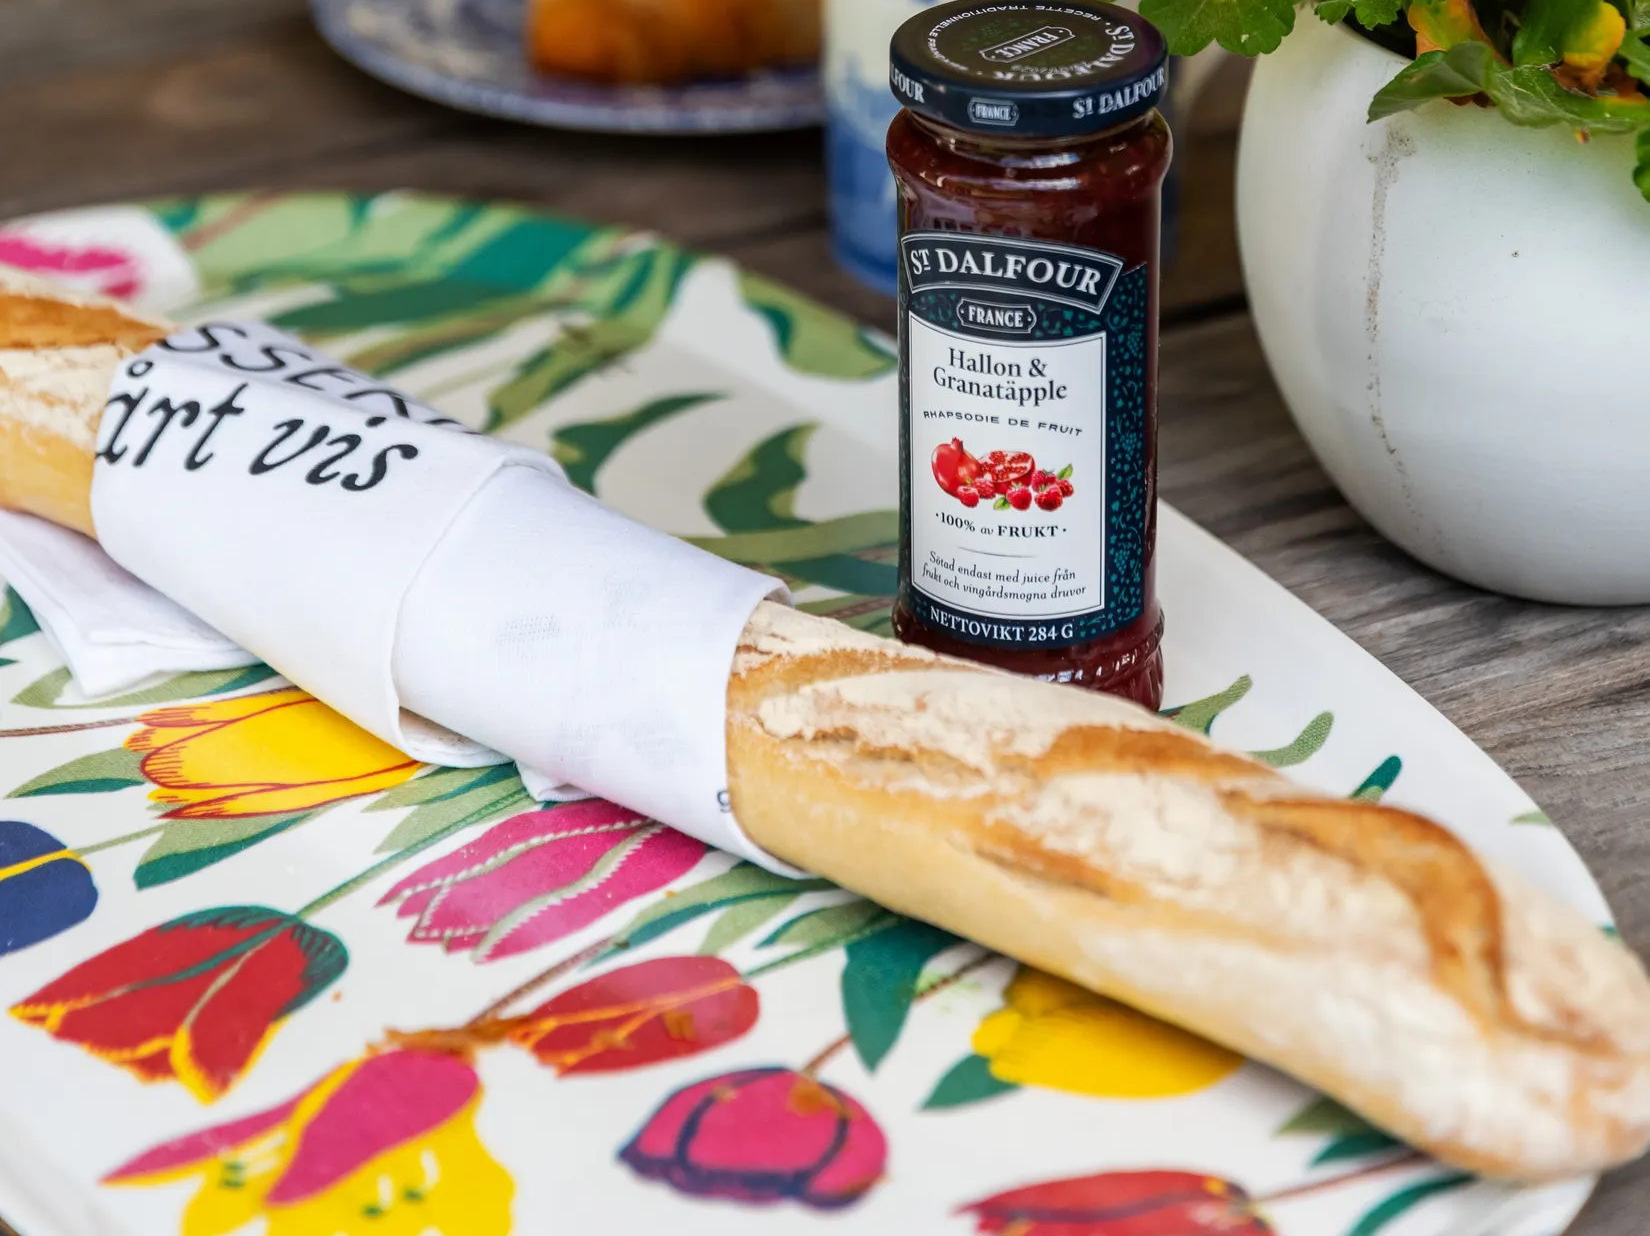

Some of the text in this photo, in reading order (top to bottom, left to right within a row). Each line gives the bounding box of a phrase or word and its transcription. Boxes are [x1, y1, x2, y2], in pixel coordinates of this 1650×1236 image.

[928, 5, 1029, 37] TRADITIONNELLE
[1035, 5, 1102, 21] RECETTE
[995, 32, 1059, 58] FRANCE
[1098, 66, 1165, 115] DALFOUR
[975, 104, 1012, 121] FRANCE
[935, 248, 1102, 296] DALFOUR
[968, 305, 1024, 328] FRANCE
[949, 347, 1048, 378] Hallon &
[933, 366, 1068, 407] Granatäpple
[923, 410, 1083, 437] RHAPSODIE DE FRUIT
[248, 416, 419, 492] vis
[980, 527, 994, 536] av
[997, 525, 1059, 539] FRUKT
[922, 563, 1087, 603] frukt och vingårdsmogna druvor
[929, 550, 1076, 586] Sötad endast med juice från
[930, 605, 1075, 642] NETTOVIKT 284 G
